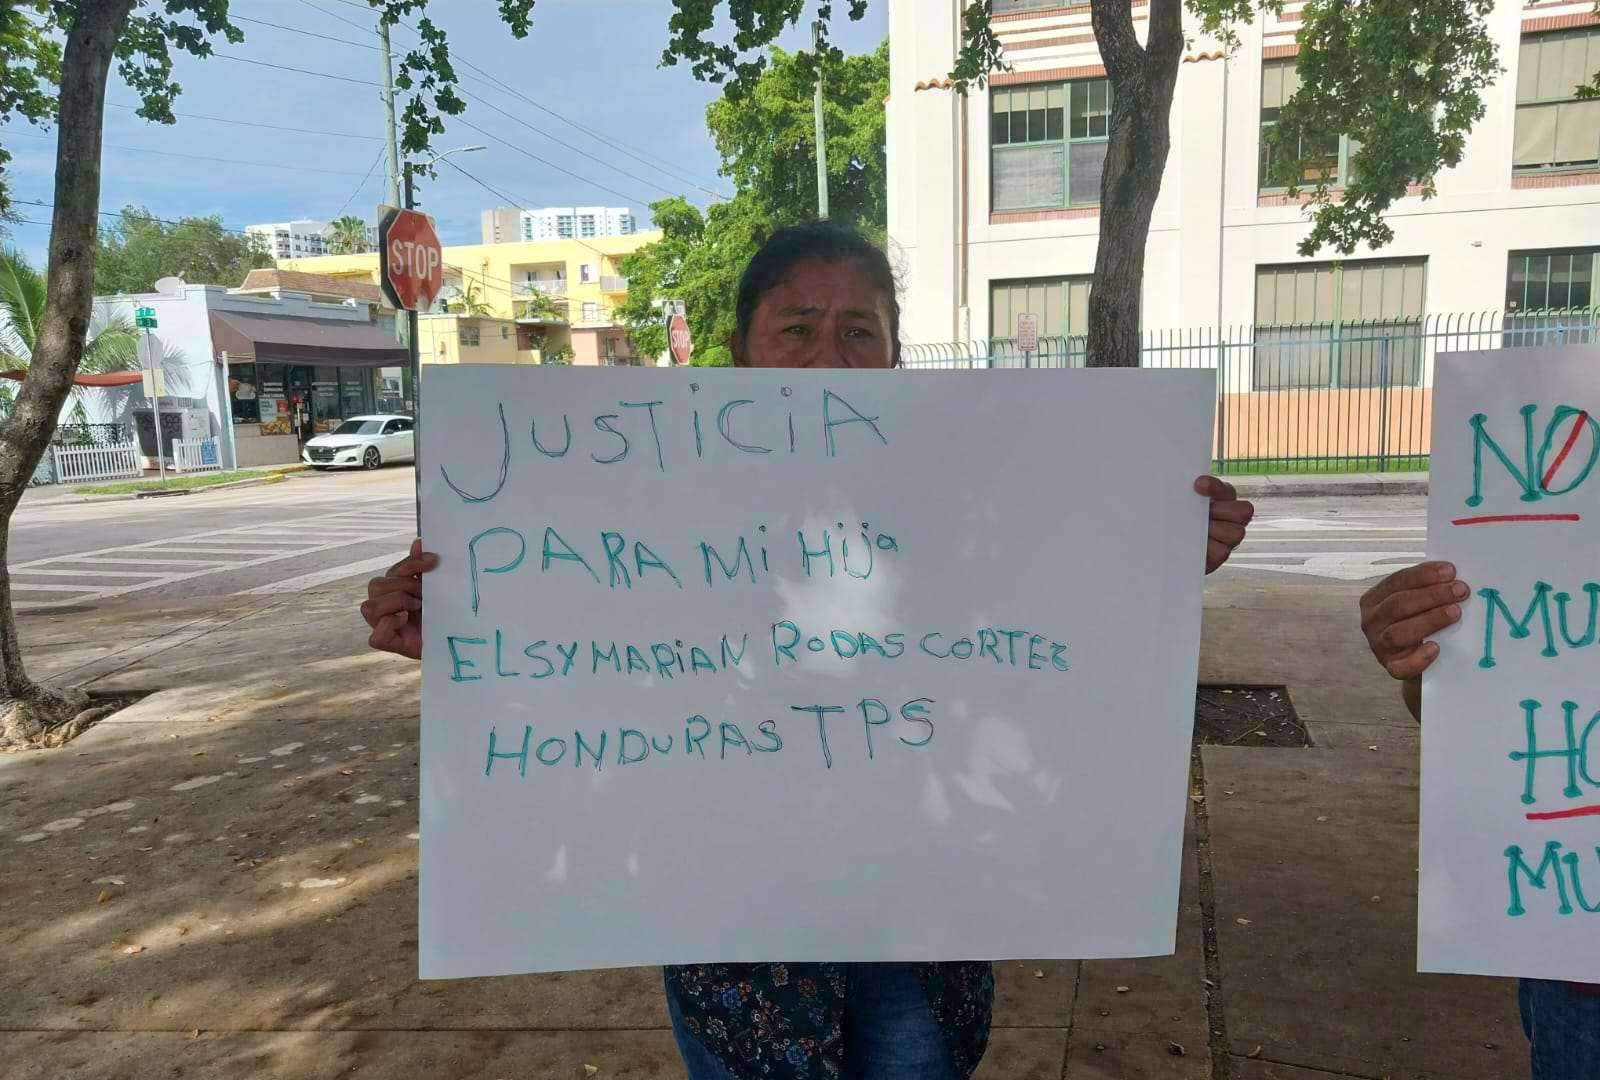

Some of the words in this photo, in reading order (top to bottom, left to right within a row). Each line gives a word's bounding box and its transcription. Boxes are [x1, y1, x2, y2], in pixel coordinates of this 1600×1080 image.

[392, 239, 438, 281] STOP
[672, 330, 690, 351] STOP
[469, 527, 682, 616] PARA
[447, 629, 580, 682] ELSY
[920, 627, 1071, 672] CORTEZ
[1477, 582, 1600, 668] MU
[485, 715, 783, 777] HONDURAS
[790, 698, 936, 769] TPS
